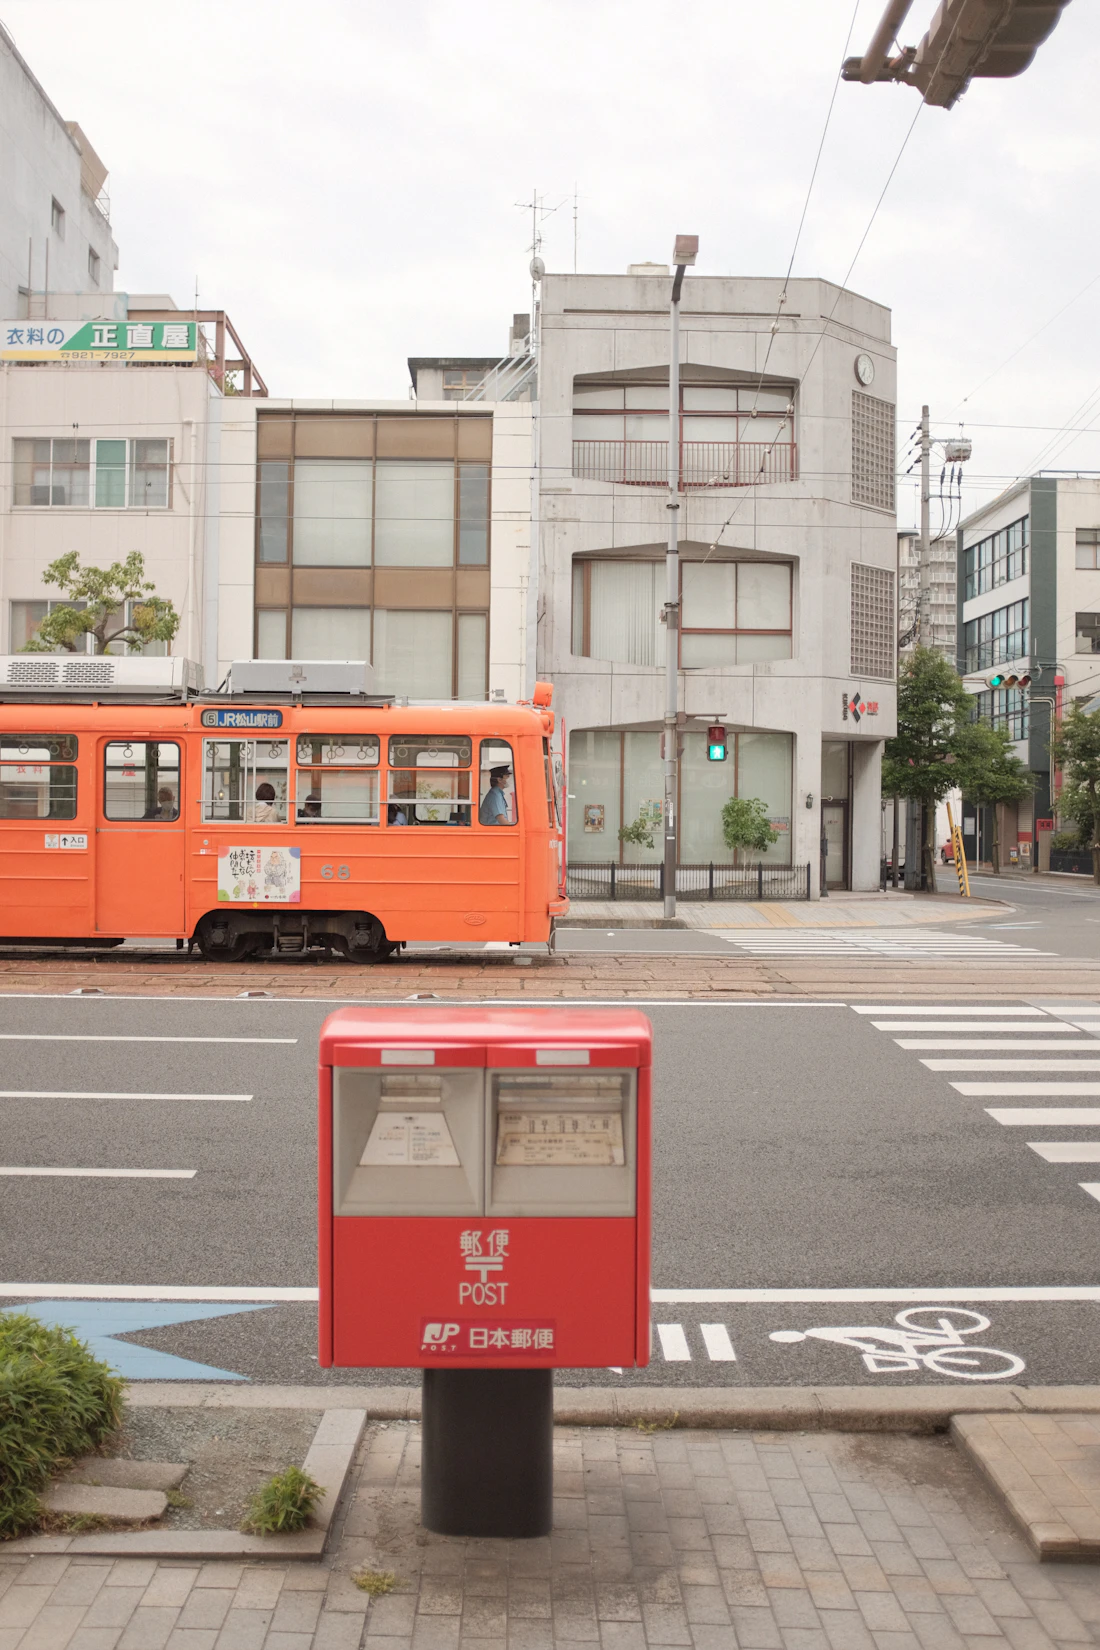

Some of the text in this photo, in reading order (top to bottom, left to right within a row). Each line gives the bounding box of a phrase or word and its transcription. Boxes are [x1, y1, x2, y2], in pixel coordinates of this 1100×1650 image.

[6, 323, 190, 349] 衣料の 正直屋
[71, 351, 136, 359] 921-7927
[219, 712, 278, 727] JR松山駅前
[70, 836, 84, 844] 入口
[320, 863, 351, 880] 68
[460, 1229, 509, 1257] 郵便
[459, 1282, 509, 1306] POST
[469, 1327, 554, 1349] 日本郵便
[421, 1344, 457, 1352] POST
